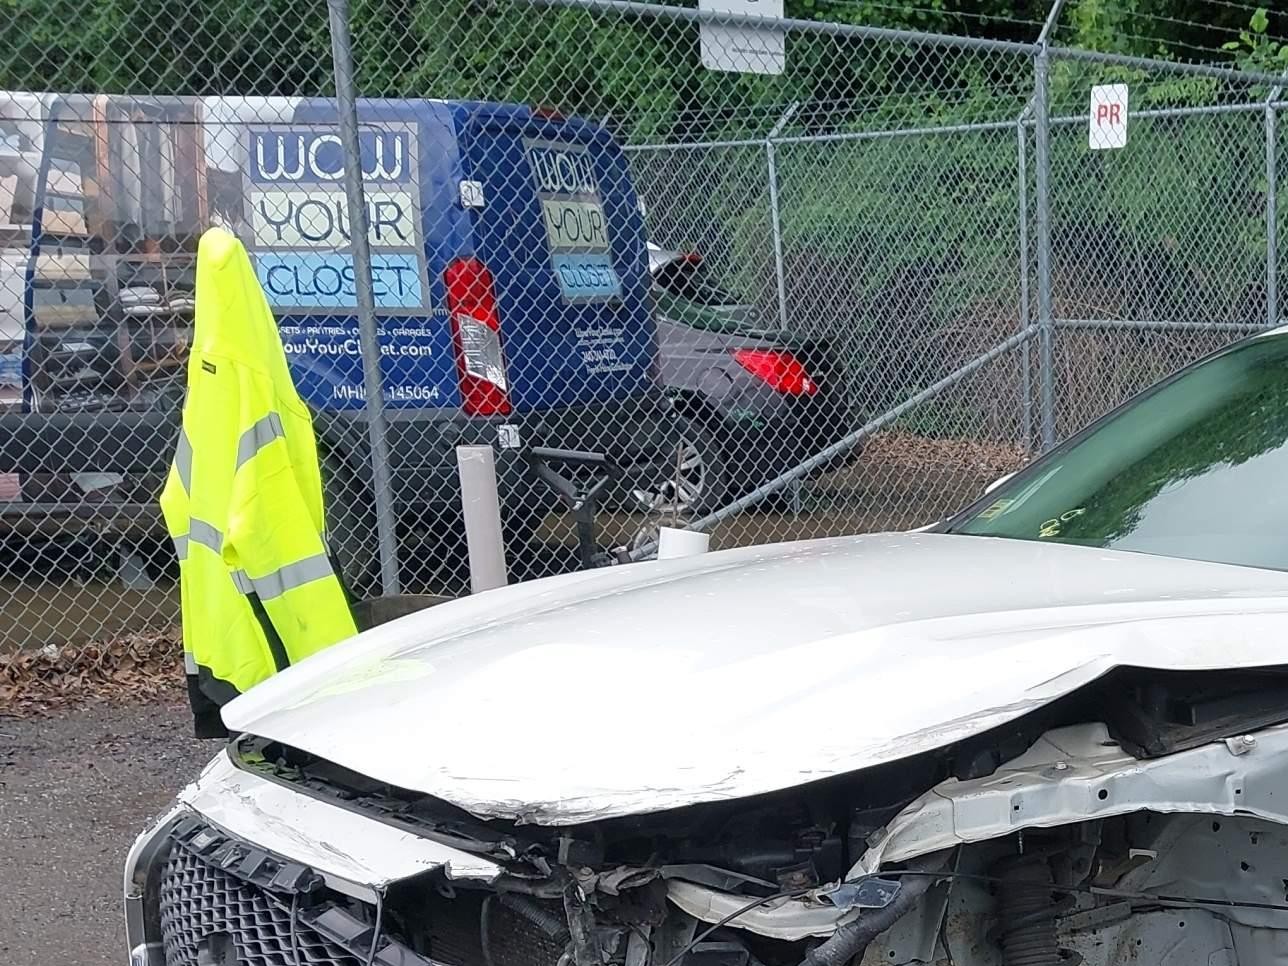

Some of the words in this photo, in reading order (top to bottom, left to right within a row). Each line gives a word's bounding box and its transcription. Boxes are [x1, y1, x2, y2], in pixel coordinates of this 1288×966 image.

[1097, 103, 1120, 125] PR
[257, 134, 402, 180] WOW
[532, 151, 595, 192] WOW
[259, 200, 406, 241] YOUR
[547, 207, 606, 243] YOUR
[267, 265, 412, 296] CLOSET
[559, 264, 614, 287] CLOSET
[333, 385, 367, 400] MHI
[388, 385, 440, 400] 145064
